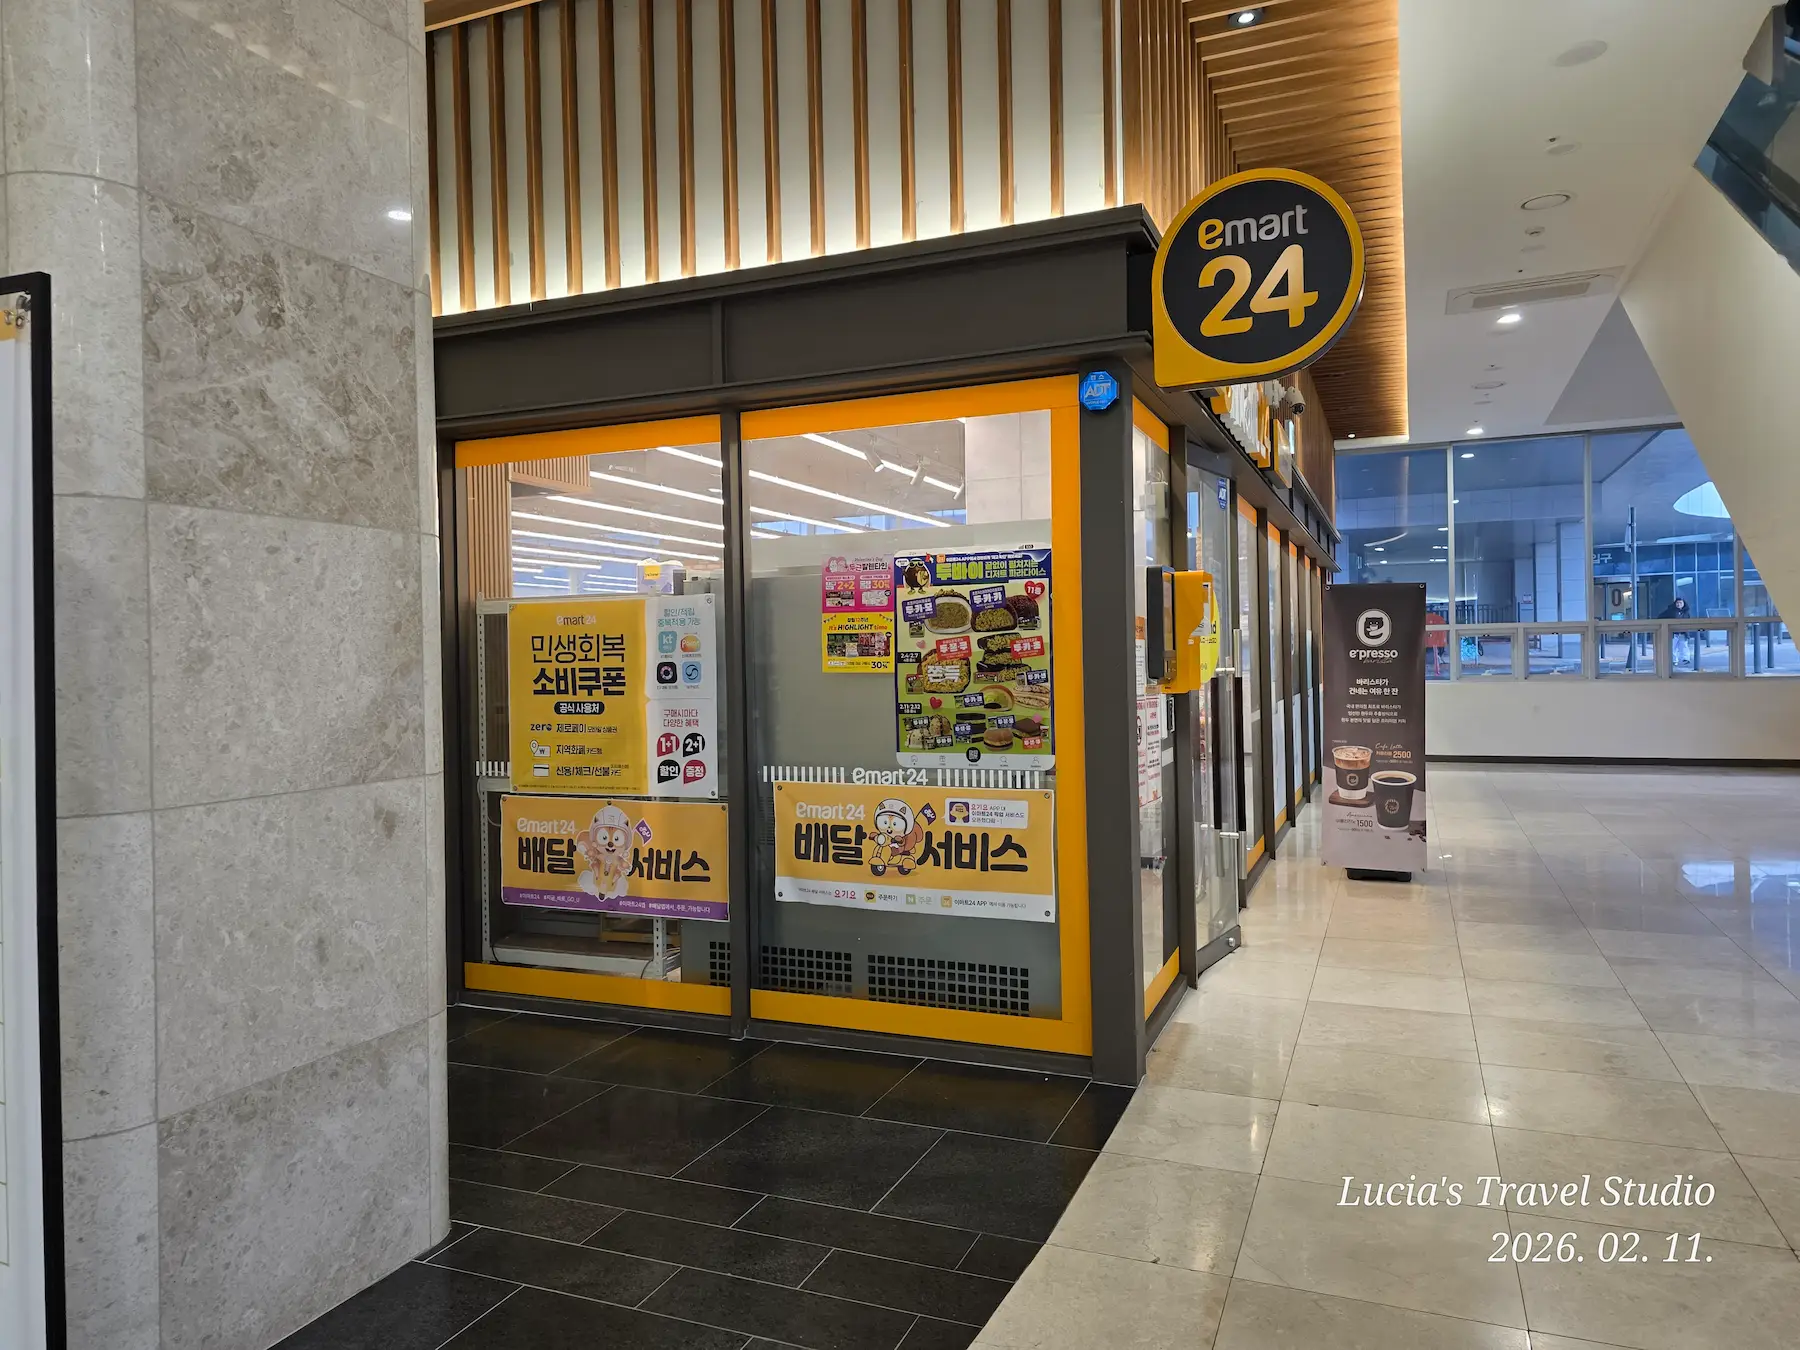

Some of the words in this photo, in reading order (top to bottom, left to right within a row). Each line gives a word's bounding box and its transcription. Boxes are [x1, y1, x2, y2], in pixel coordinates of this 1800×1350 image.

[1198, 205, 1308, 250] emart
[1198, 244, 1319, 337] 24
[1084, 383, 1110, 397] ADT
[985, 561, 1007, 570] 끝없이
[1008, 559, 1038, 569] 펼쳐지는
[936, 562, 983, 580] 두바이
[985, 569, 1007, 578] 디저트
[1008, 567, 1046, 578] 파라다이스
[838, 581, 855, 590] 2+2
[531, 633, 626, 663] 민생회복
[532, 667, 626, 696] 소비쿠폰
[1356, 678, 1389, 686] 바리스타가
[1349, 687, 1368, 695] 건네는
[1369, 687, 1382, 695] 여유
[1383, 687, 1390, 695] 한
[1391, 687, 1399, 695] 잔
[560, 703, 575, 713] 공식
[576, 703, 600, 714] 사용처
[556, 723, 587, 733] 제로페이
[663, 719, 683, 728] 다양한
[685, 719, 699, 728] 혜택
[556, 744, 586, 755] 지역화폐
[660, 736, 677, 752] 1+1
[685, 736, 703, 752] 2+1
[556, 766, 610, 777] 신용/체크/선불
[660, 765, 678, 776] 할인
[686, 765, 704, 777] 증정
[853, 767, 929, 786] emart24
[796, 802, 866, 821] emart24
[971, 803, 988, 811] 요기요
[517, 817, 576, 835] emart24
[1357, 819, 1373, 827] 1500
[795, 822, 868, 866] 배달
[917, 830, 1029, 872] 서비스
[518, 837, 577, 874] 배달
[627, 848, 711, 882] 서비스
[834, 889, 857, 899] 요기요
[878, 893, 898, 901] 주문하기
[954, 898, 976, 906] 이마트24
